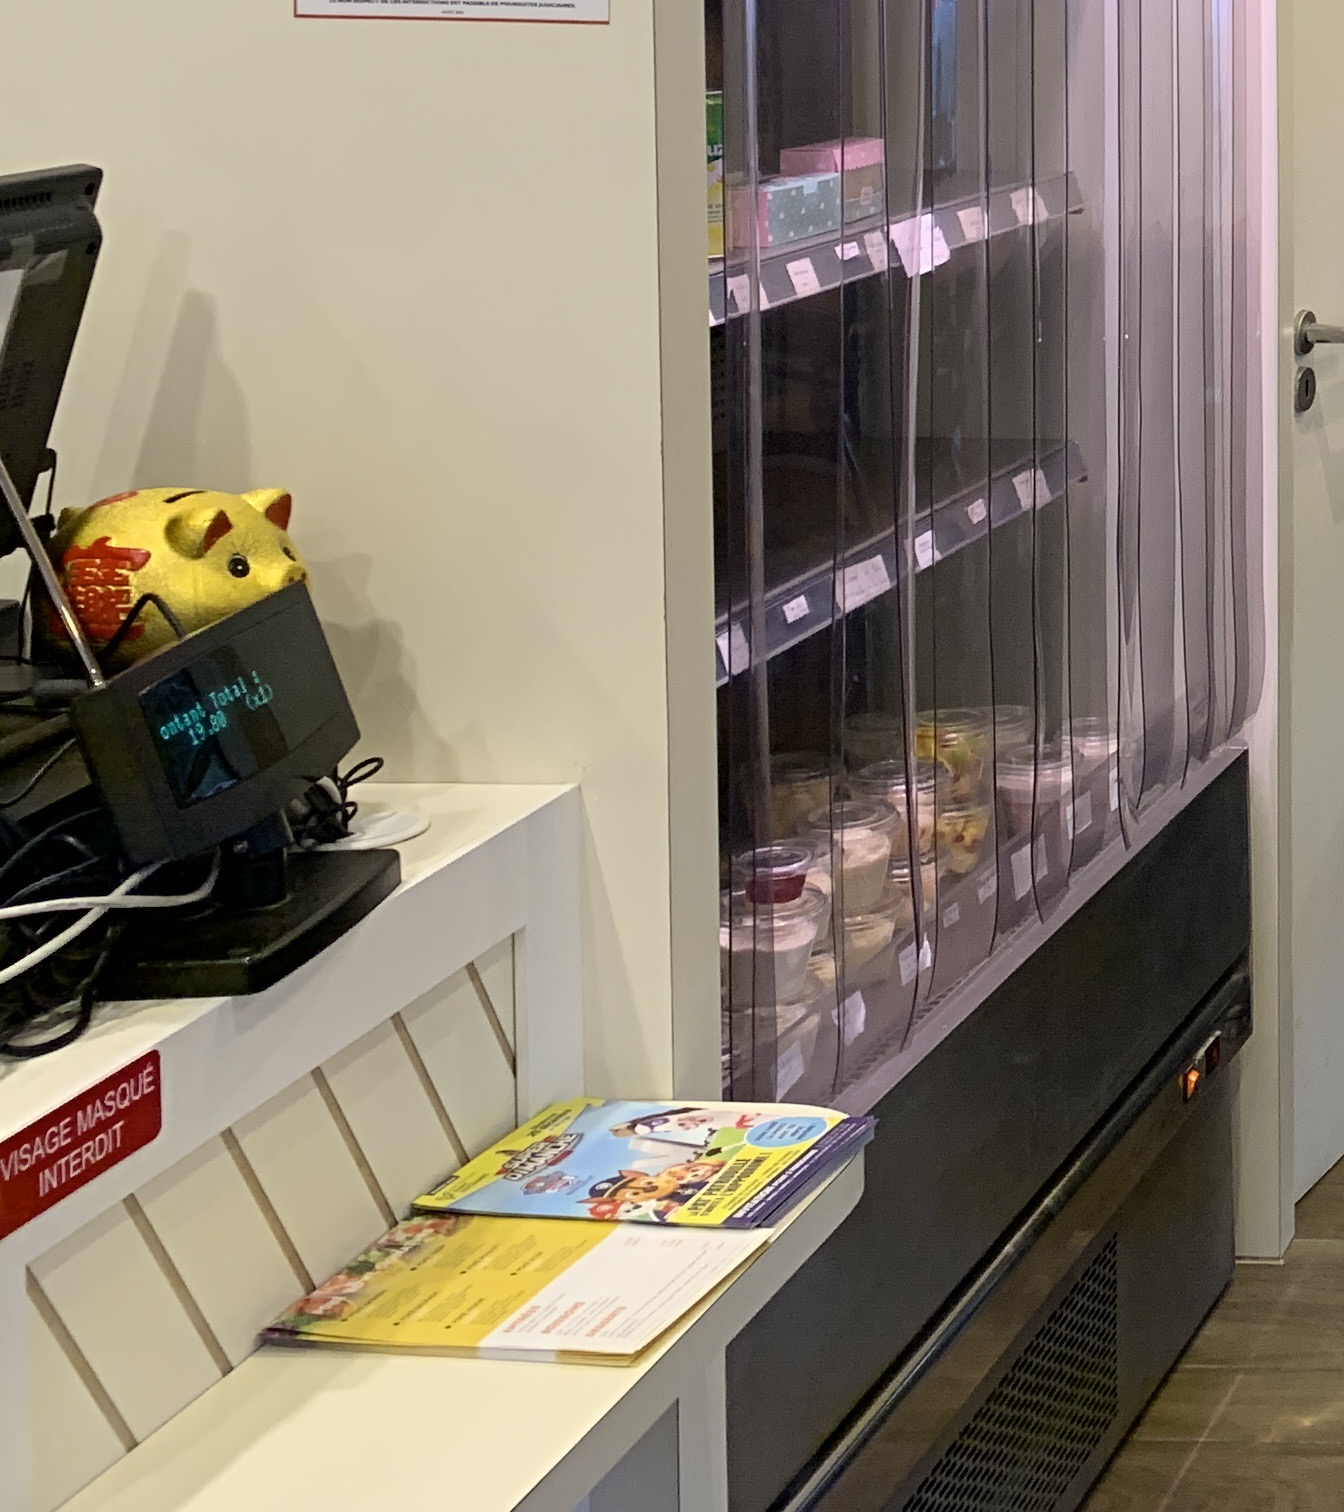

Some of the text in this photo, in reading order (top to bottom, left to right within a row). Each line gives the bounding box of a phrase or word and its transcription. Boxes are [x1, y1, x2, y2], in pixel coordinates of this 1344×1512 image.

[208, 675, 247, 709] Total
[0, 1061, 156, 1181] VISAGE MASQUÉ
[38, 1120, 125, 1198] INTERDIT
